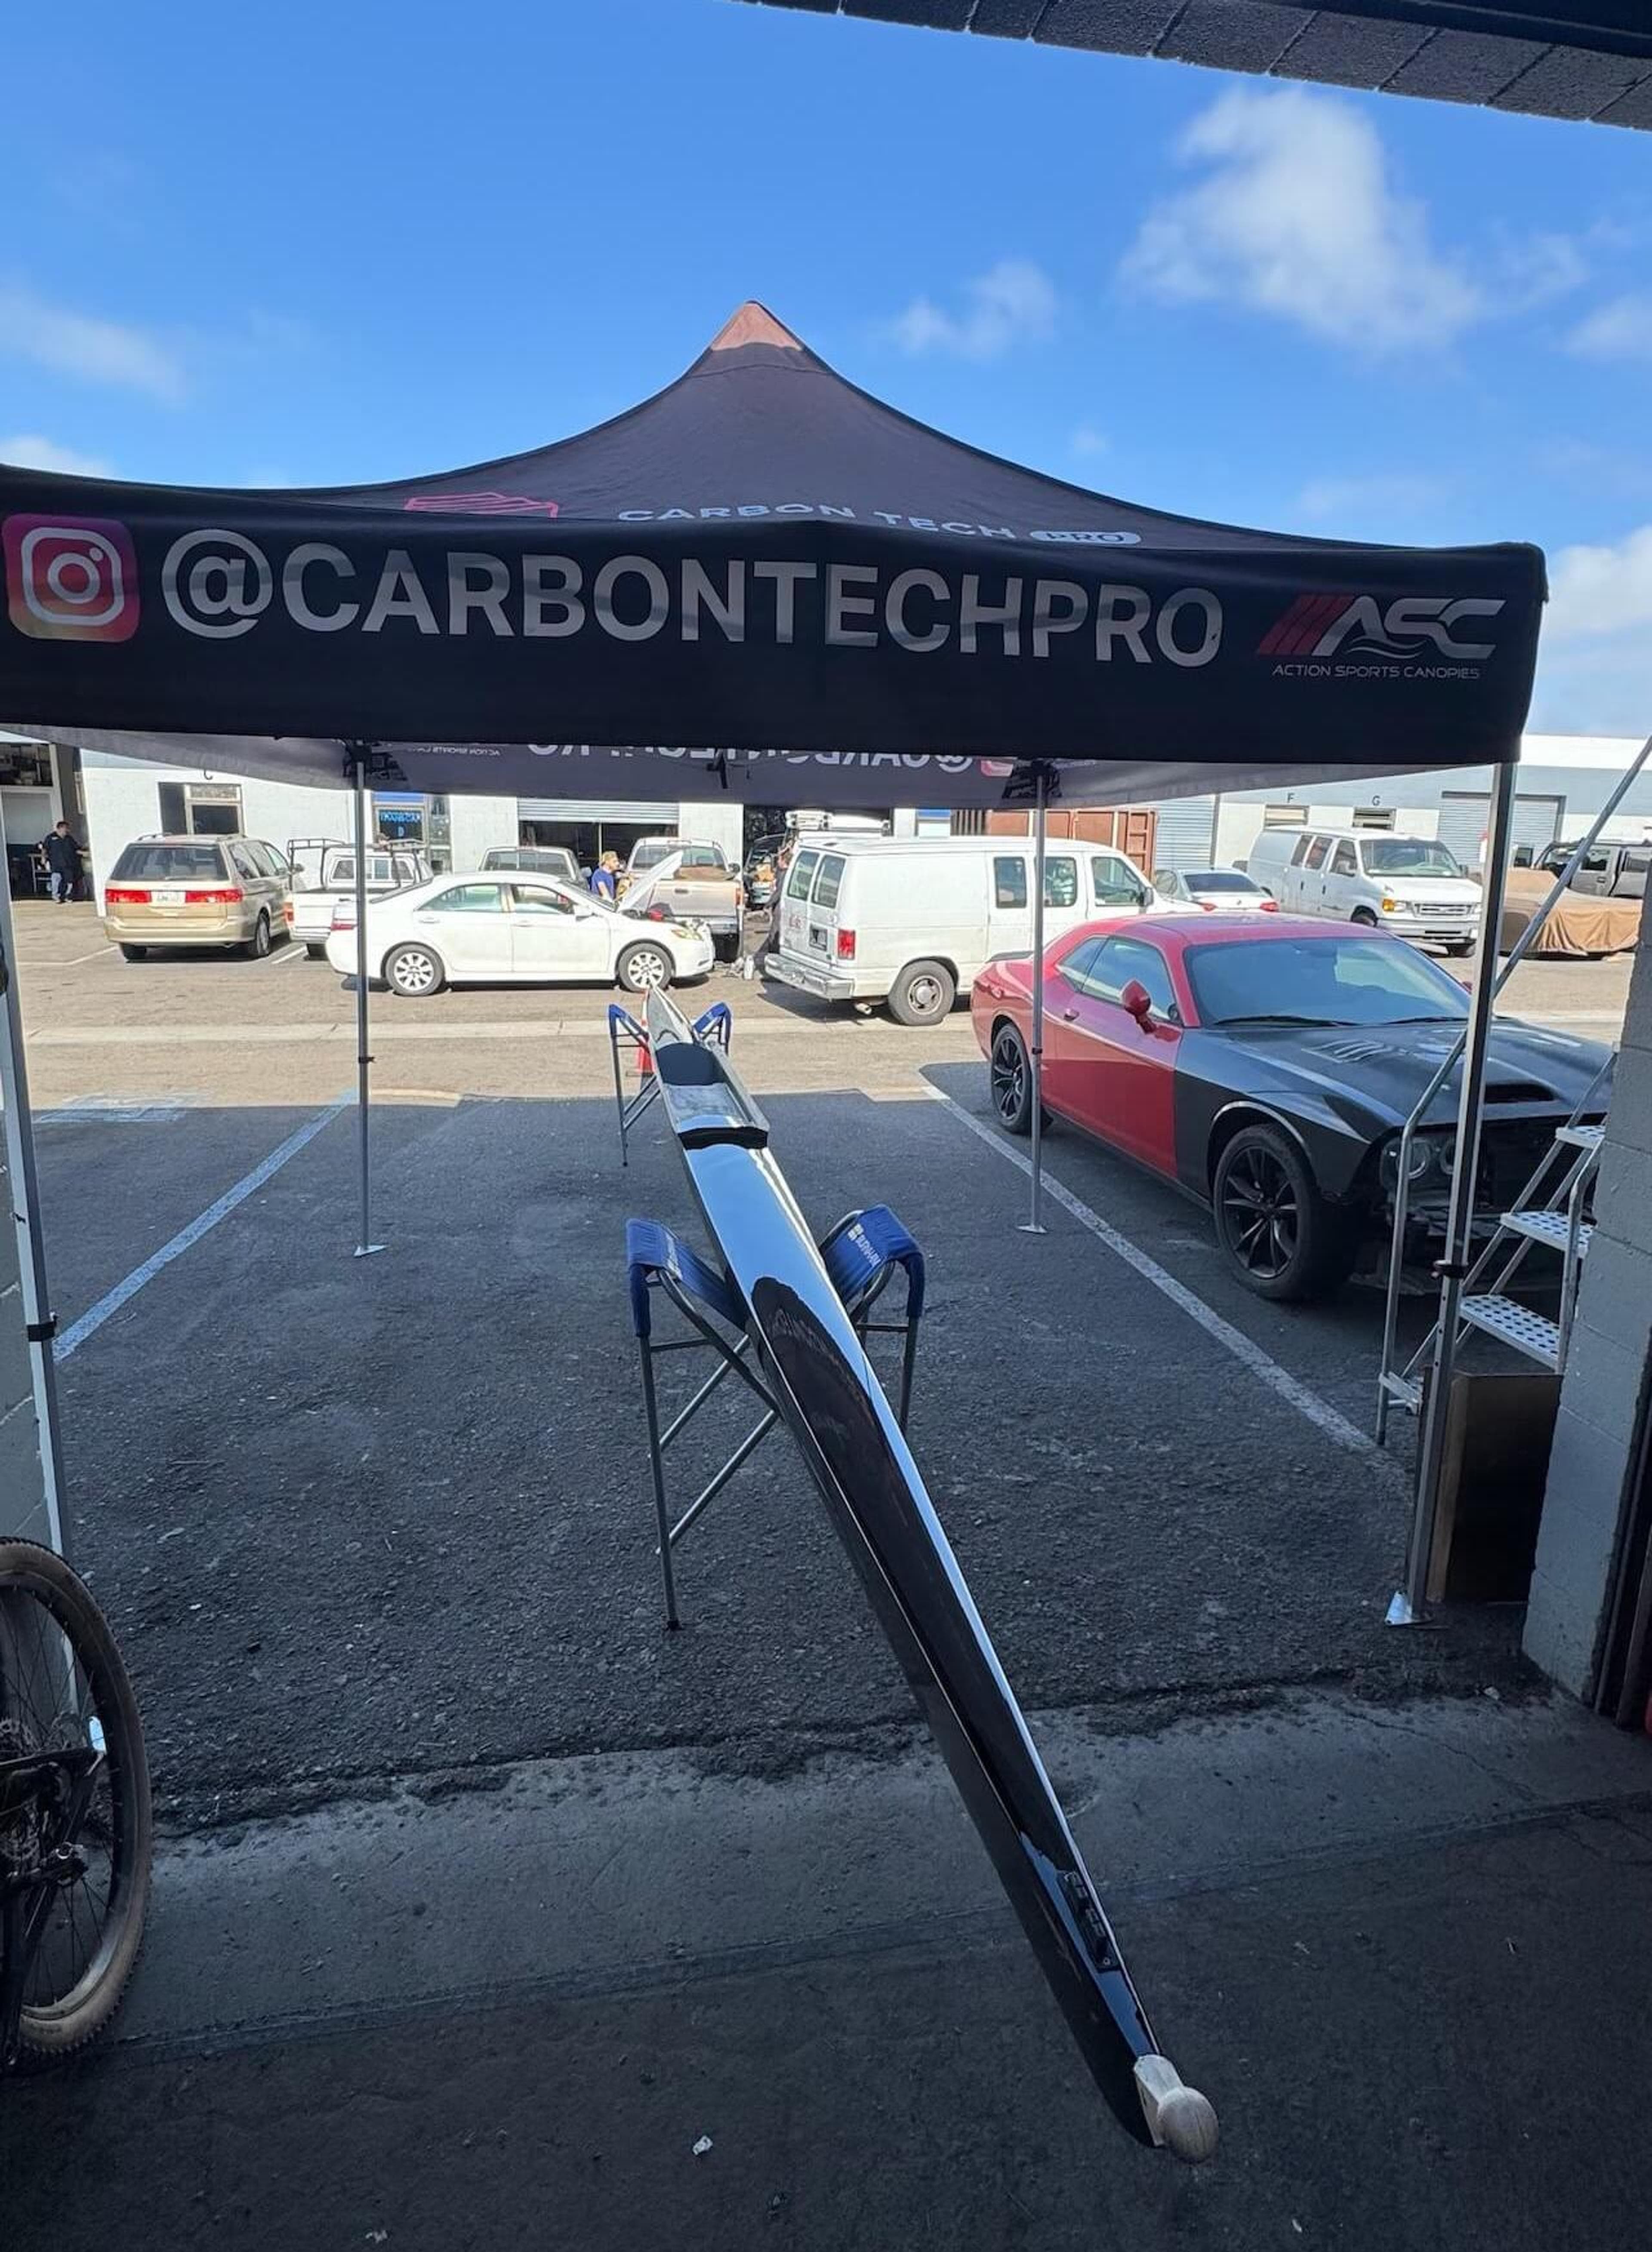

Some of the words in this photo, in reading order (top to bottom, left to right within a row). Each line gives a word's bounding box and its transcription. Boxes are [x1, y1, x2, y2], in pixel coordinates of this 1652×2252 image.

[618, 504, 857, 521] CARBON
[873, 511, 1016, 538] TECH
[1045, 533, 1125, 543] PRO
[161, 528, 1224, 668] @CARBONTECHPRO
[1311, 595, 1506, 659] ASC
[1272, 665, 1331, 678] ACTION
[1335, 665, 1400, 678] SPORTS
[1404, 667, 1480, 680] CANOPIES
[1287, 792, 1295, 803] F
[1372, 795, 1381, 806] G
